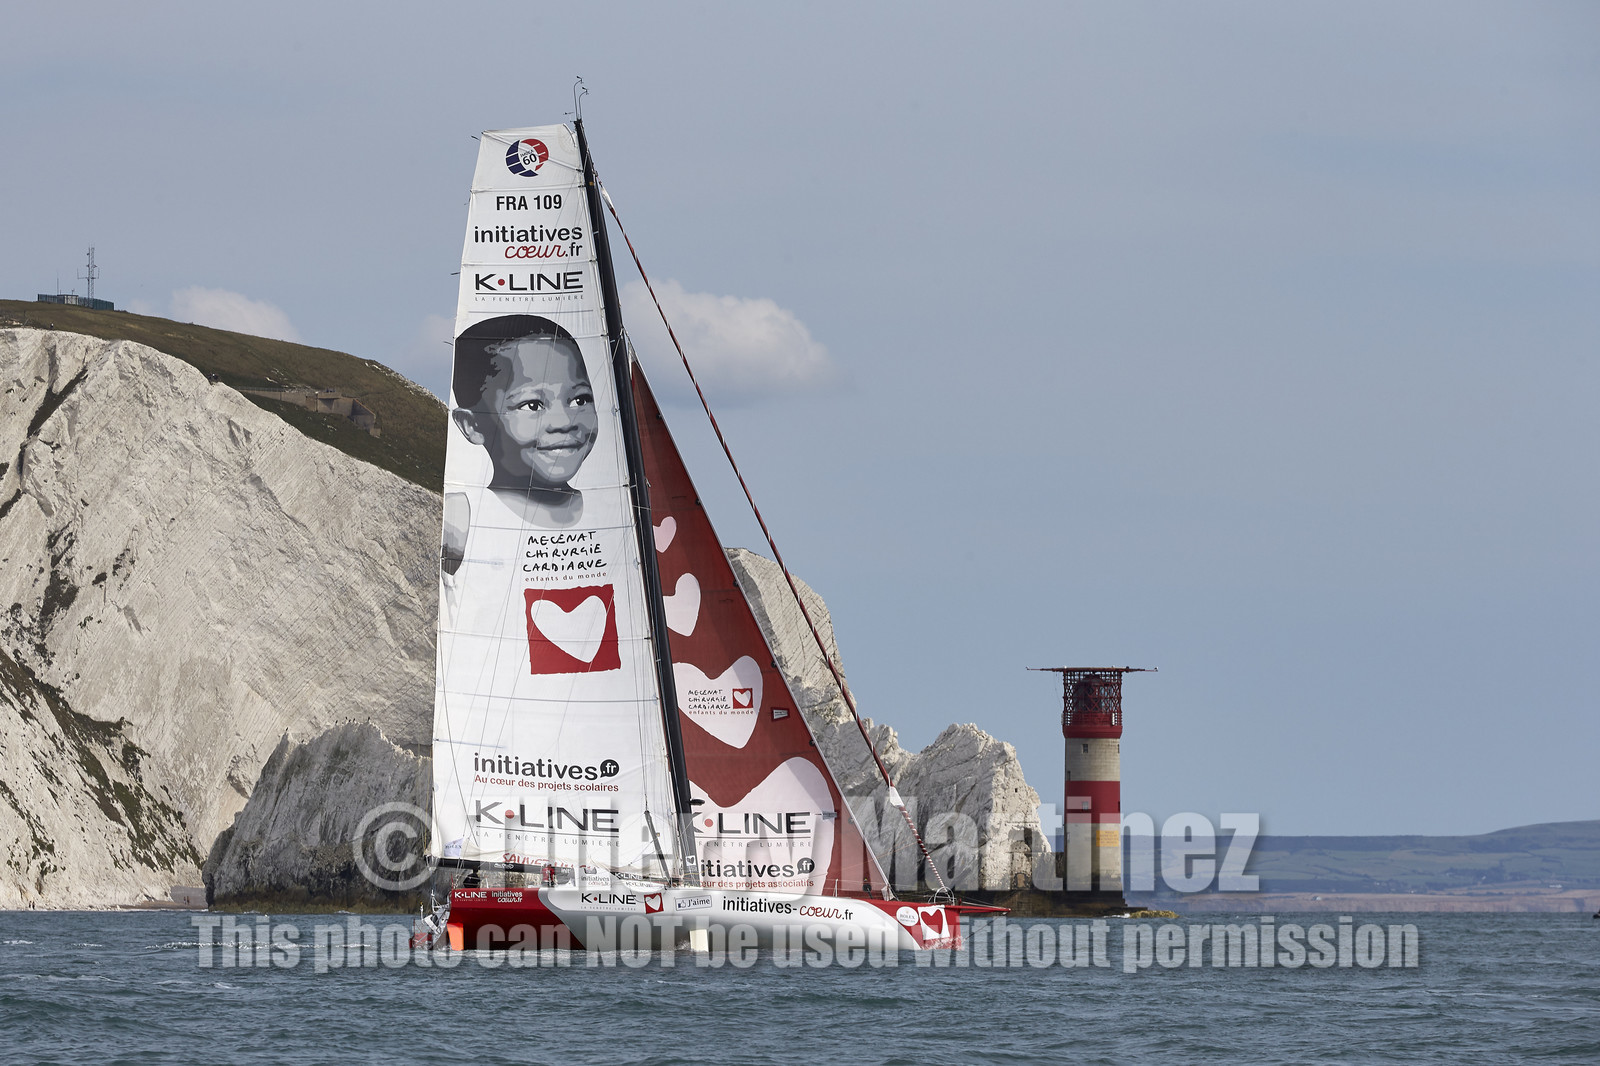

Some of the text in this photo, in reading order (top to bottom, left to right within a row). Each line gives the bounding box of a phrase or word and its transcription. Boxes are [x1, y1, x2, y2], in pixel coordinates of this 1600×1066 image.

[523, 153, 537, 165] 60
[496, 194, 562, 210] FRA 109
[474, 225, 583, 243] initiatives
[527, 531, 597, 545] MECENAT
[577, 571, 608, 579] monde
[474, 775, 619, 792] Au cœur des projets scolaires
[564, 838, 619, 847] LUMIÈRE
[718, 880, 733, 888] des
[735, 880, 766, 889] projets
[767, 879, 814, 888] associatifs
[491, 890, 523, 898] initiatives
[687, 898, 711, 909] J'aime
